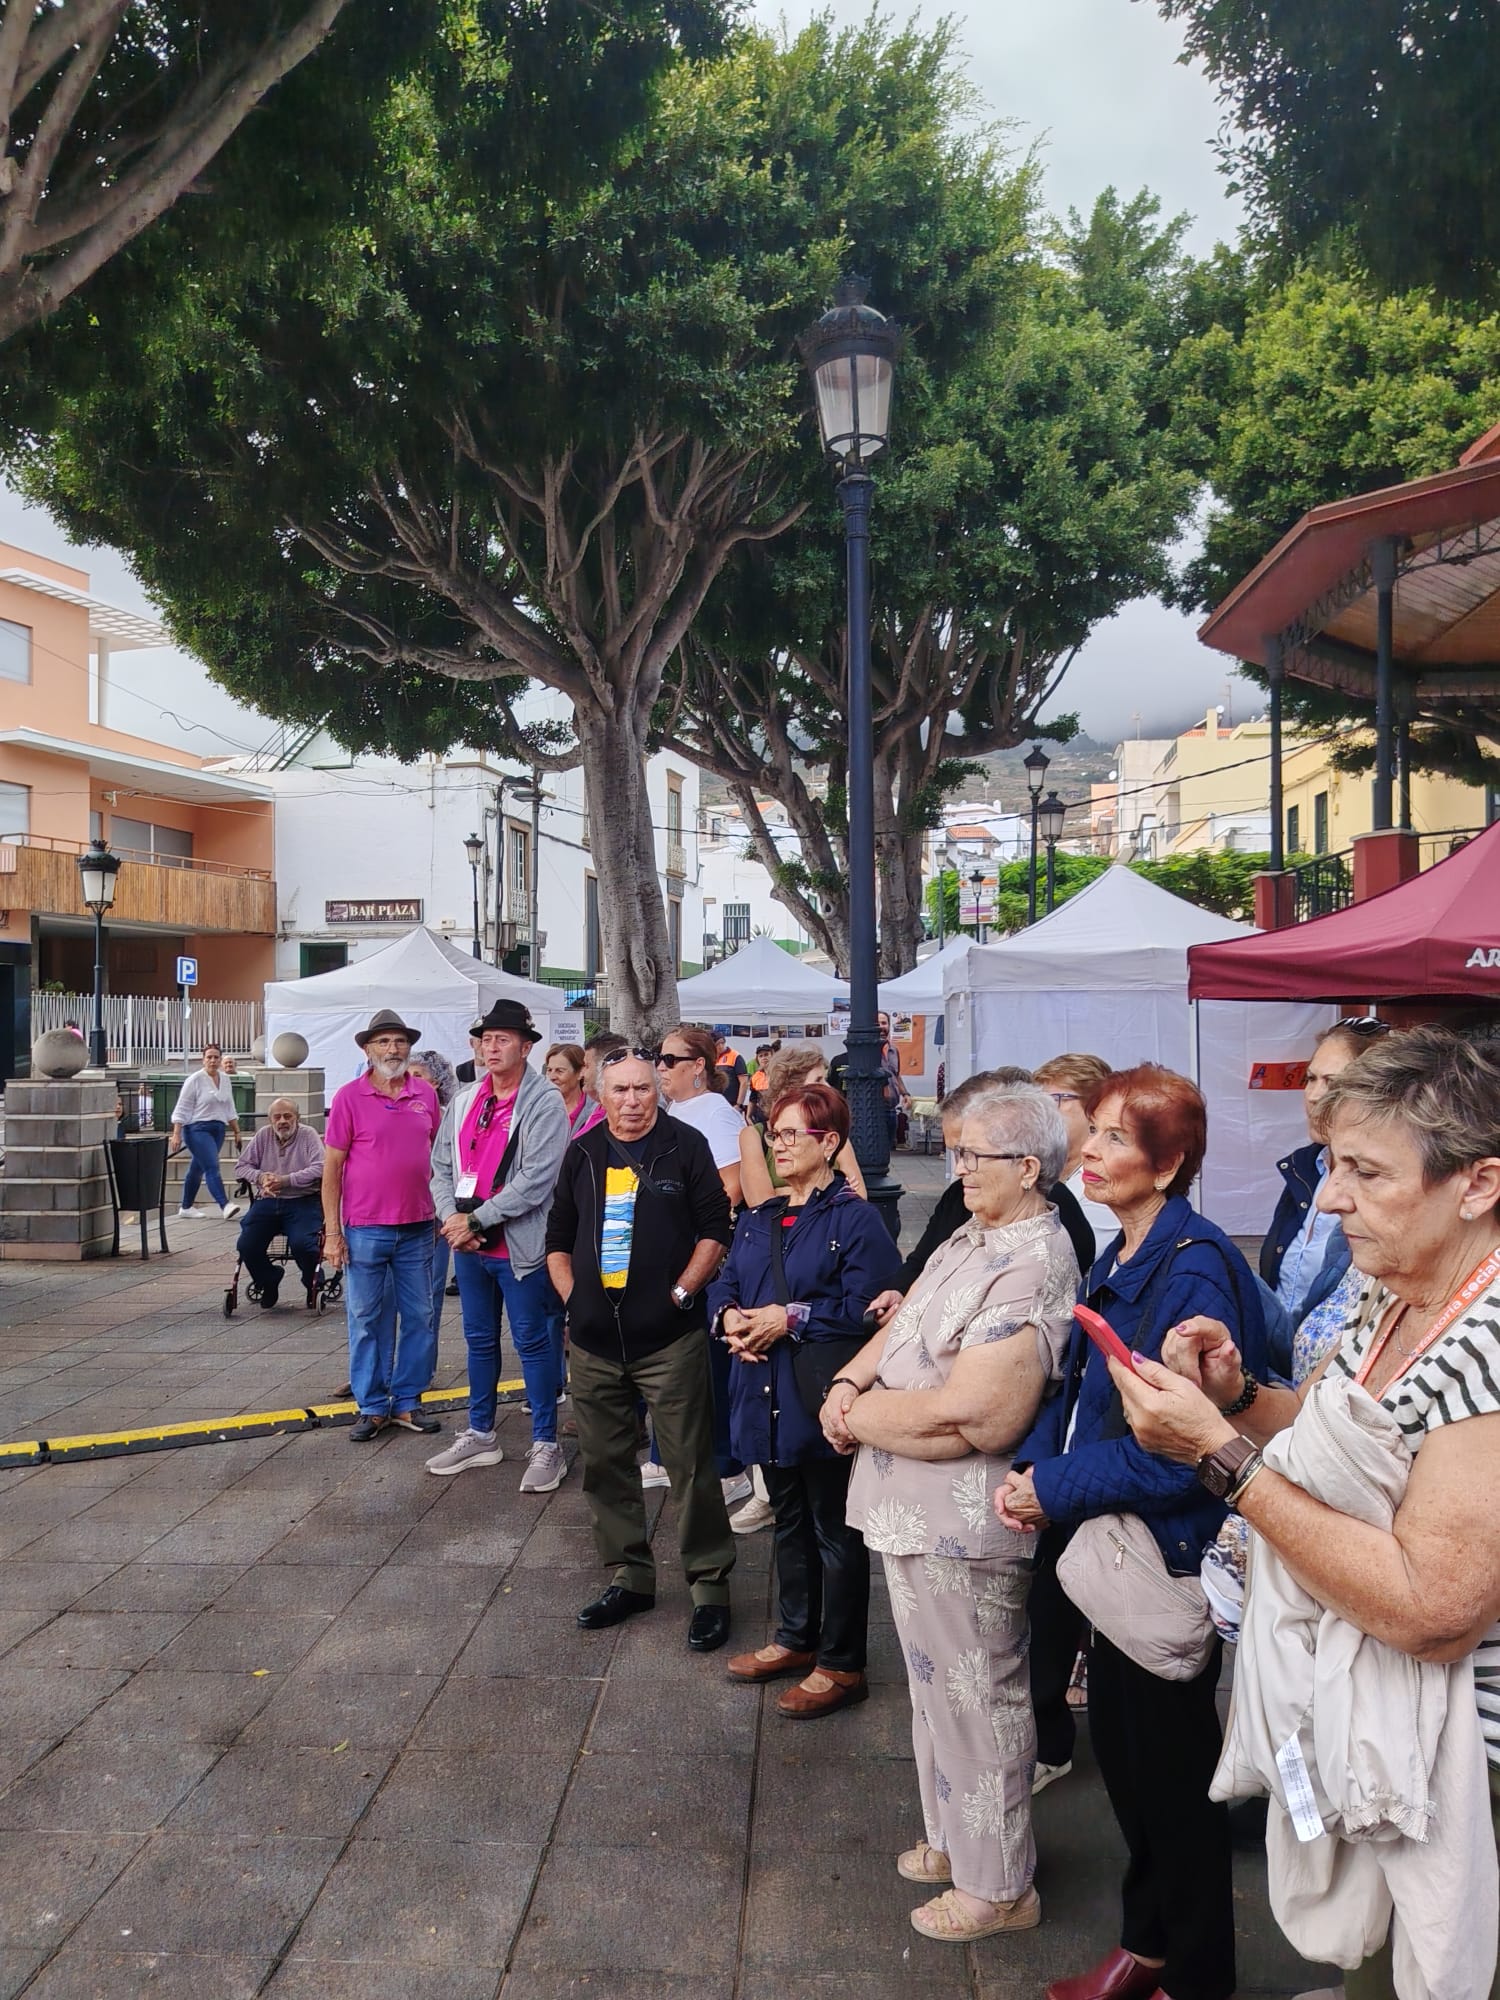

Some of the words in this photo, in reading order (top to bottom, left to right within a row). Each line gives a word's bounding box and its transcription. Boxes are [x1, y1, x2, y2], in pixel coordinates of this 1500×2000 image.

[350, 905, 375, 917] BAR
[378, 904, 416, 916] PLAZA
[182, 960, 195, 981] P
[1461, 1258, 1500, 1299] social
